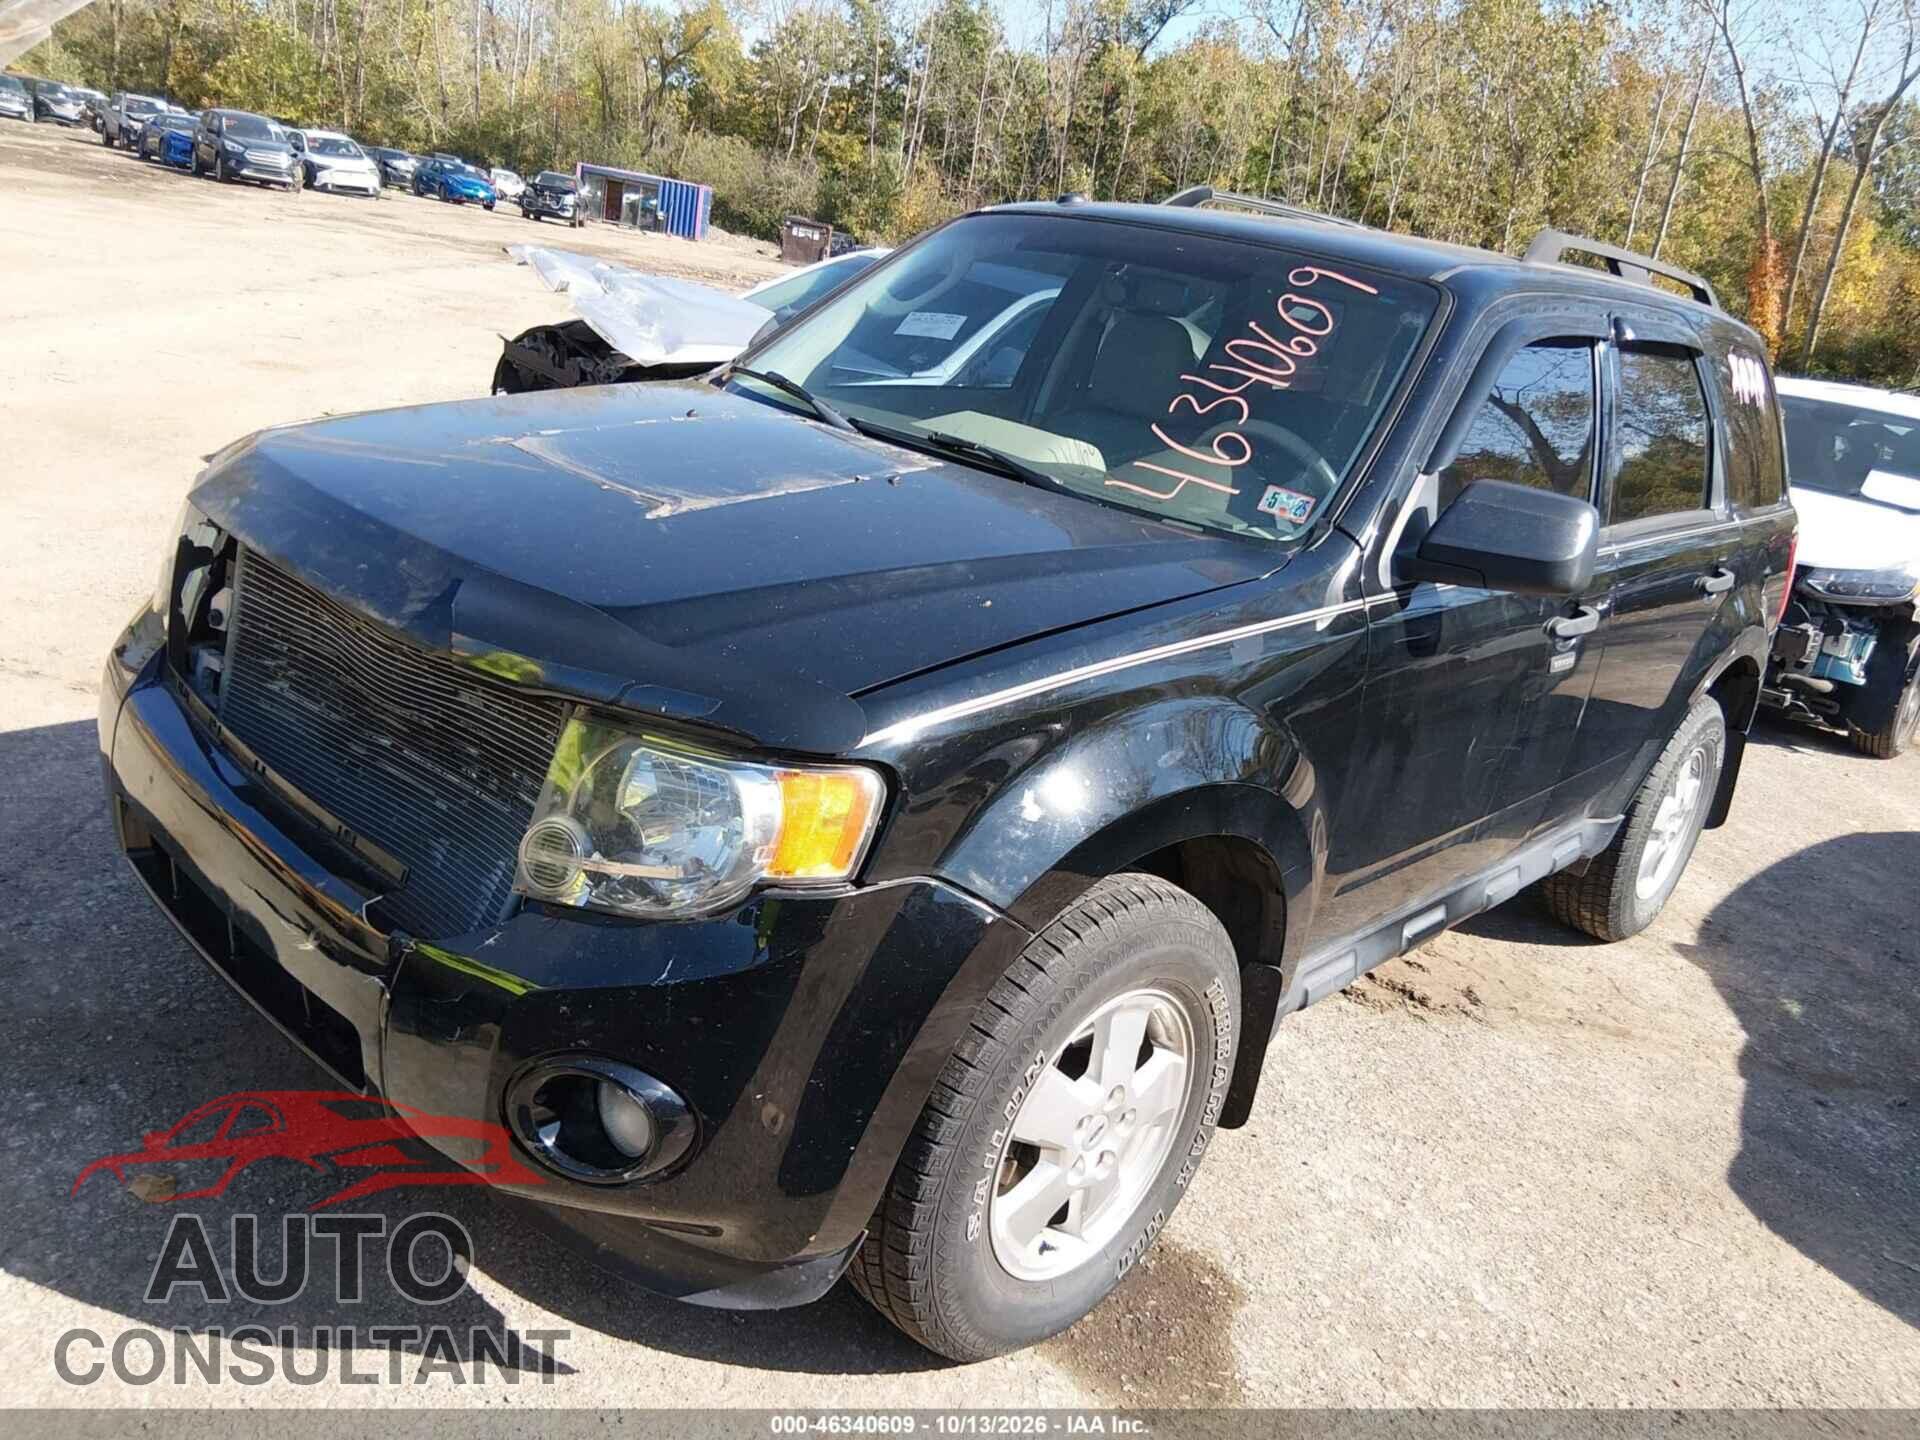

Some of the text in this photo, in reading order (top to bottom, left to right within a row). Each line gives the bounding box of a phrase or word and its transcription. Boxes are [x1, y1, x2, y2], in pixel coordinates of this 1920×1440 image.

[1104, 266, 1378, 499] 46340609
[966, 1049, 1046, 1242] SAILUN
[1175, 977, 1232, 1188] TERRAMAX
